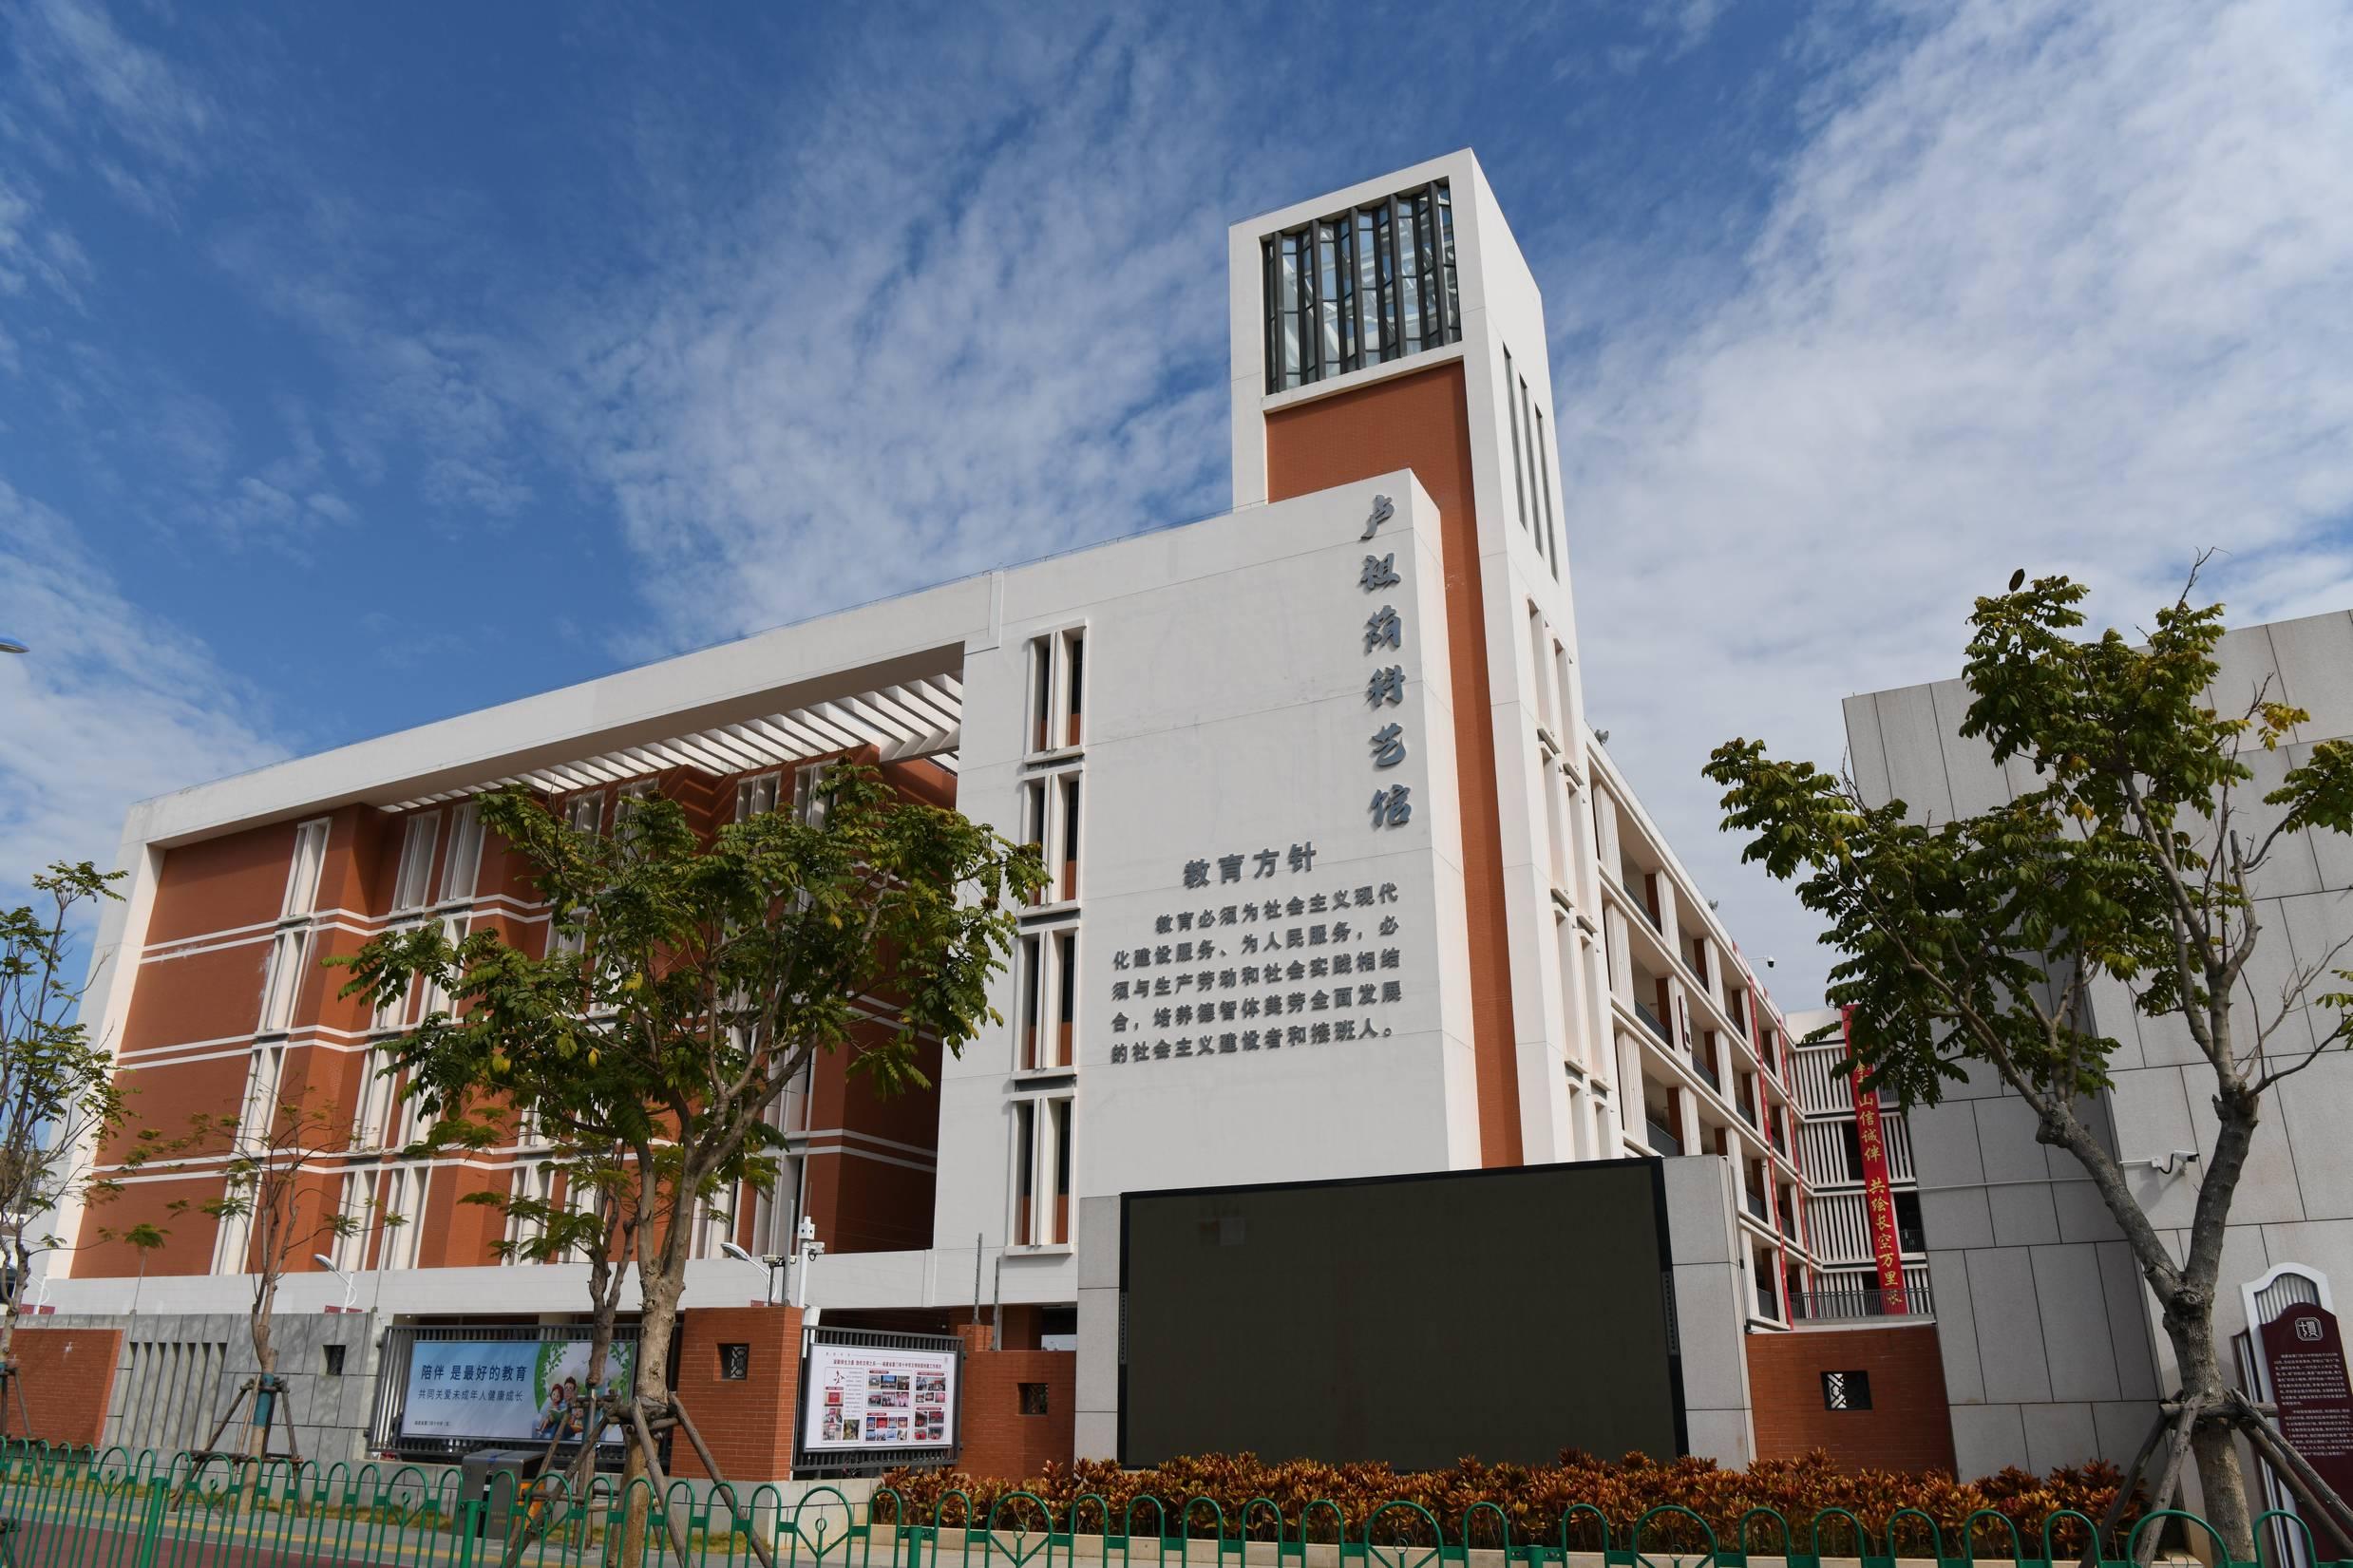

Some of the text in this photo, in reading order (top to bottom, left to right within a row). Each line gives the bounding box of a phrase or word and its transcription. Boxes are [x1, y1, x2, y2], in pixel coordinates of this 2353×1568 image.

[1360, 494, 1412, 828] 卢祖荫科艺馆
[1183, 841, 1316, 890] 教育方针
[1155, 882, 1398, 935] 教育必须为社会主义现代
[1113, 915, 1399, 971] 化建设服务、为人民服务，必
[1111, 948, 1400, 1001] 须与生产劳动和社会实践相结
[1110, 980, 1401, 1033] 合，培养德智体美劳全面发展
[1110, 1017, 1393, 1065] 的社会主义建设者和接班人。
[418, 1389, 524, 1403] 共同关爱未成年人健康成长
[421, 1365, 528, 1382] 陪伴 是最好的教育
